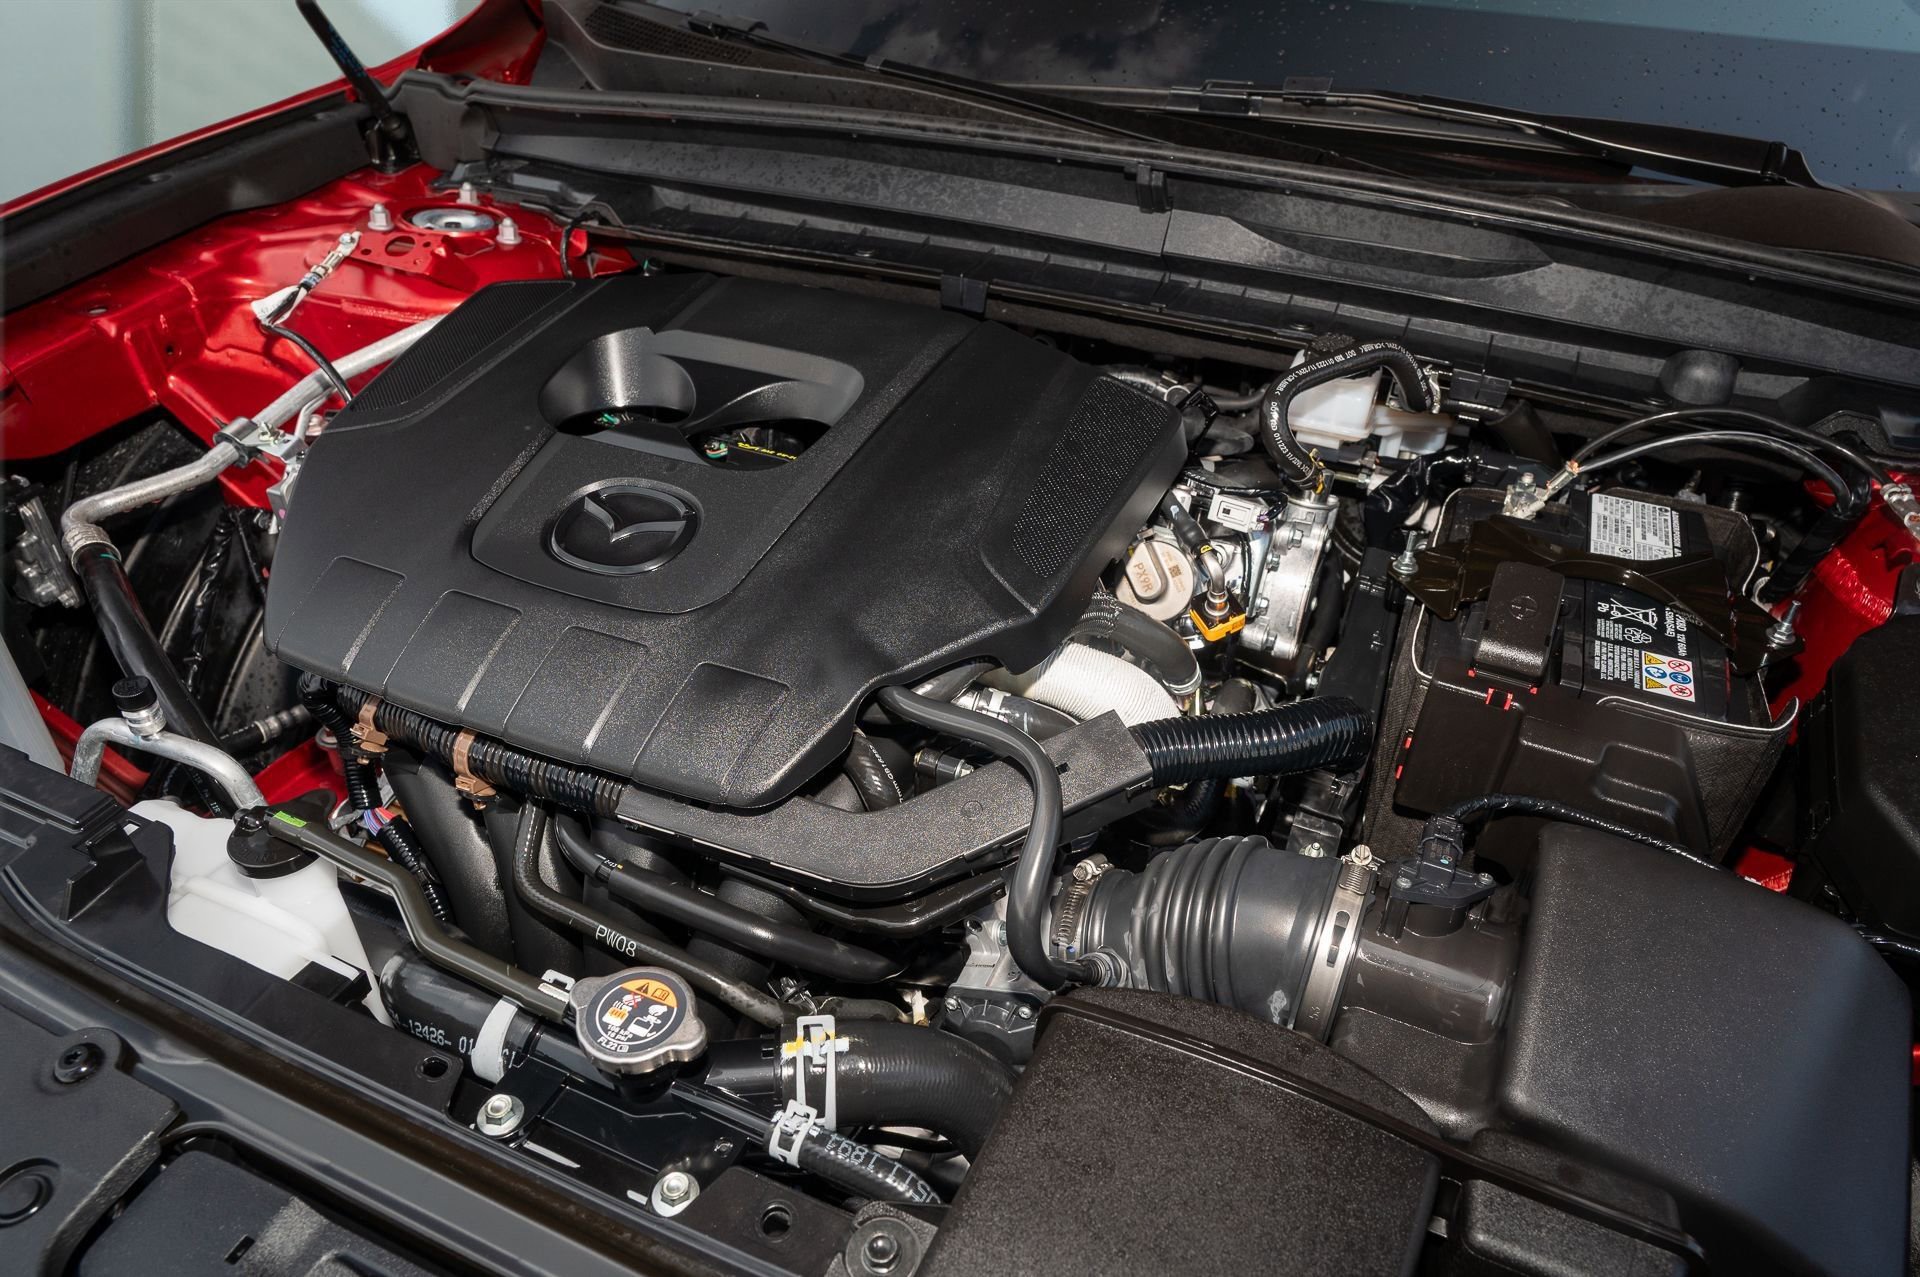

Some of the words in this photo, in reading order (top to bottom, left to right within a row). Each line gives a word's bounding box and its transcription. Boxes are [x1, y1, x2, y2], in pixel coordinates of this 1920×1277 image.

[1273, 433, 1287, 454] 011223
[1134, 562, 1153, 593] PX9R
[1597, 602, 1610, 613] Pb
[595, 924, 637, 958] PW08
[597, 1036, 618, 1051] FL22
